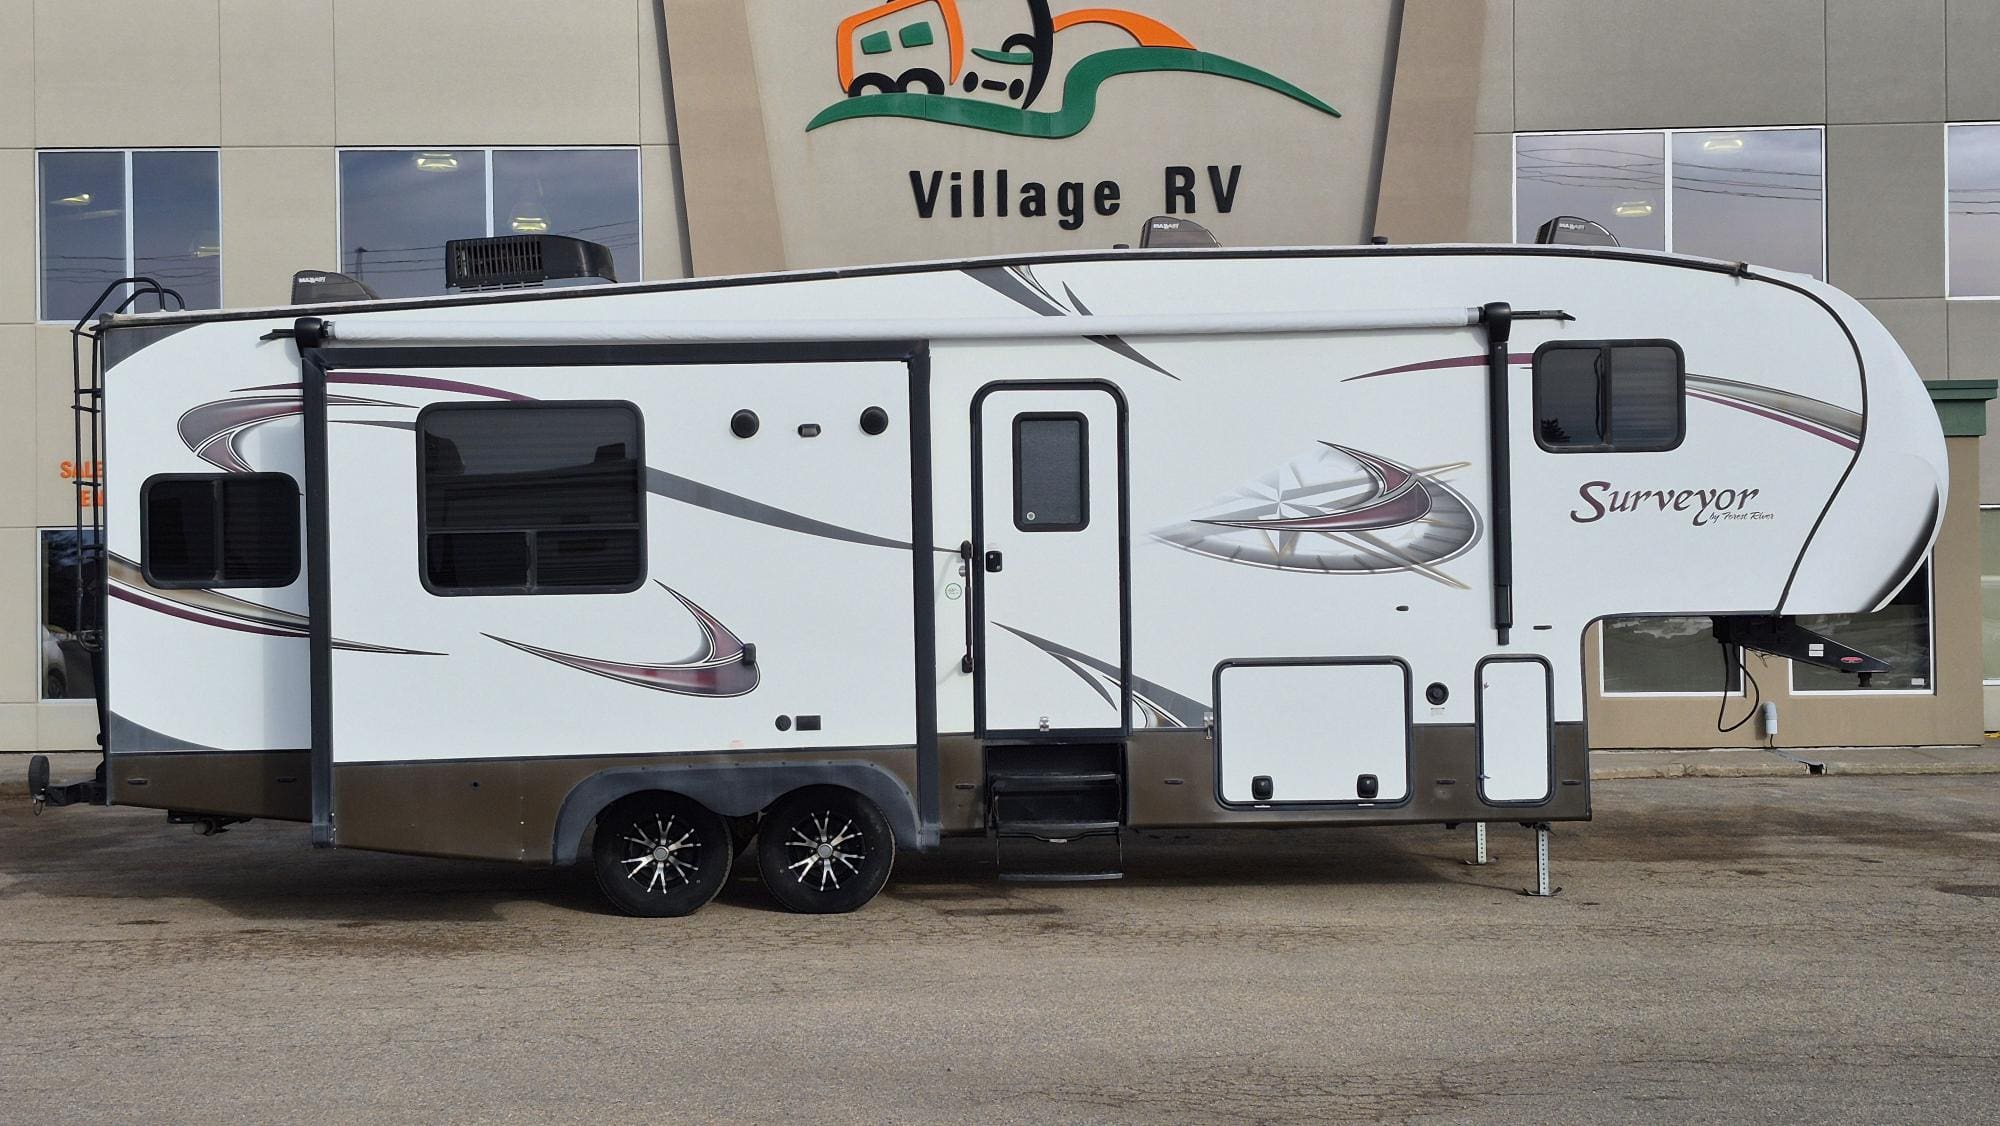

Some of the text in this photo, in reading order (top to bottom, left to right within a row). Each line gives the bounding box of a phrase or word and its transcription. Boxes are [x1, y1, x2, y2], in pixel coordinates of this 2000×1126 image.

[909, 165, 1242, 230] Village RV
[1570, 481, 1759, 526] Surveyor
[1709, 511, 1775, 523] by Forest River
